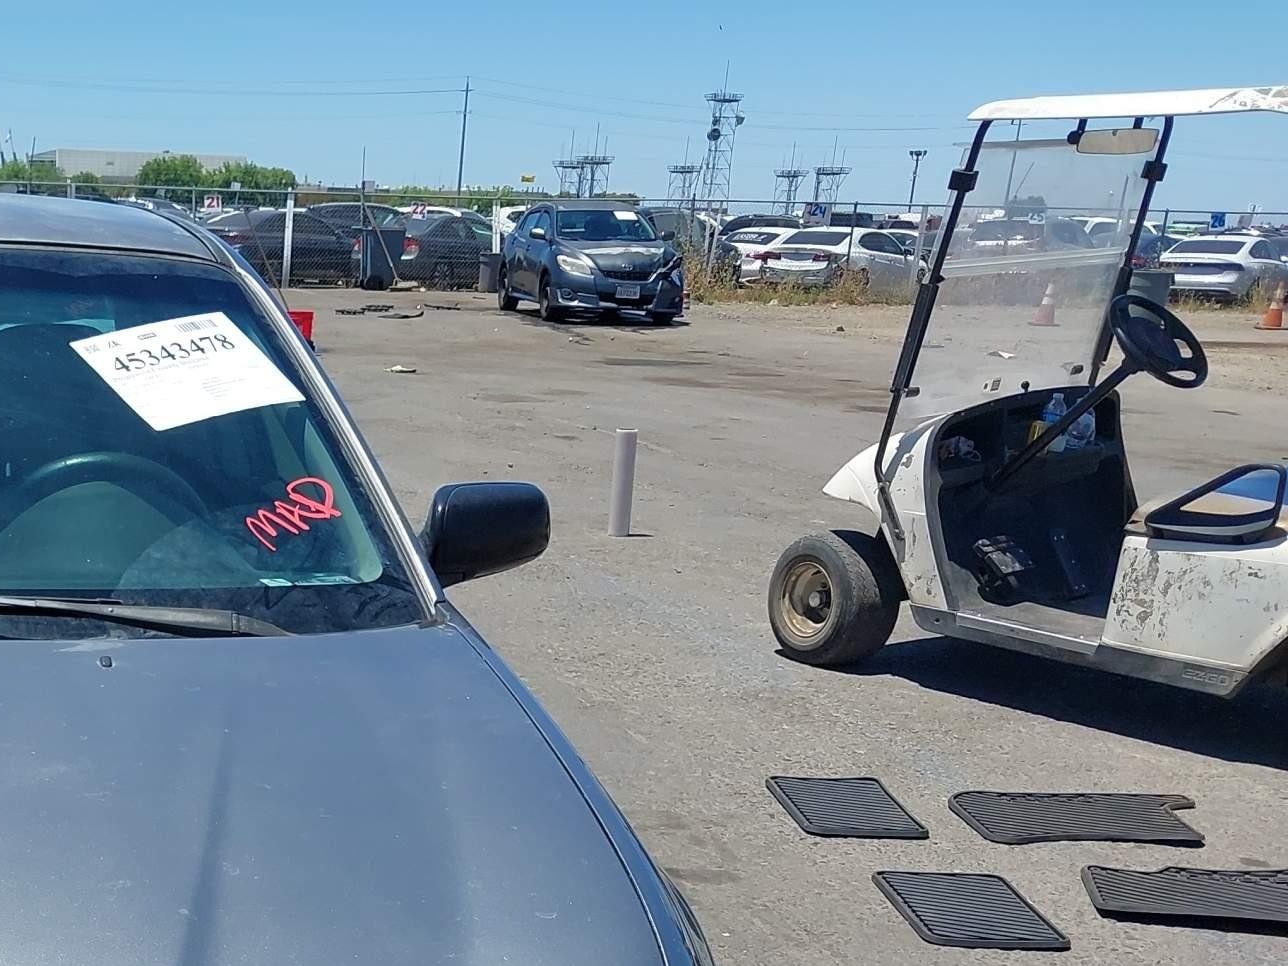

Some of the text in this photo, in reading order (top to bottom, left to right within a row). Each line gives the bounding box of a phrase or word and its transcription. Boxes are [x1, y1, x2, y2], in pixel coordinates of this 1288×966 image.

[207, 197, 220, 208] 21
[412, 203, 426, 214] 22
[1211, 214, 1225, 228] 26
[114, 333, 236, 372] 45343478
